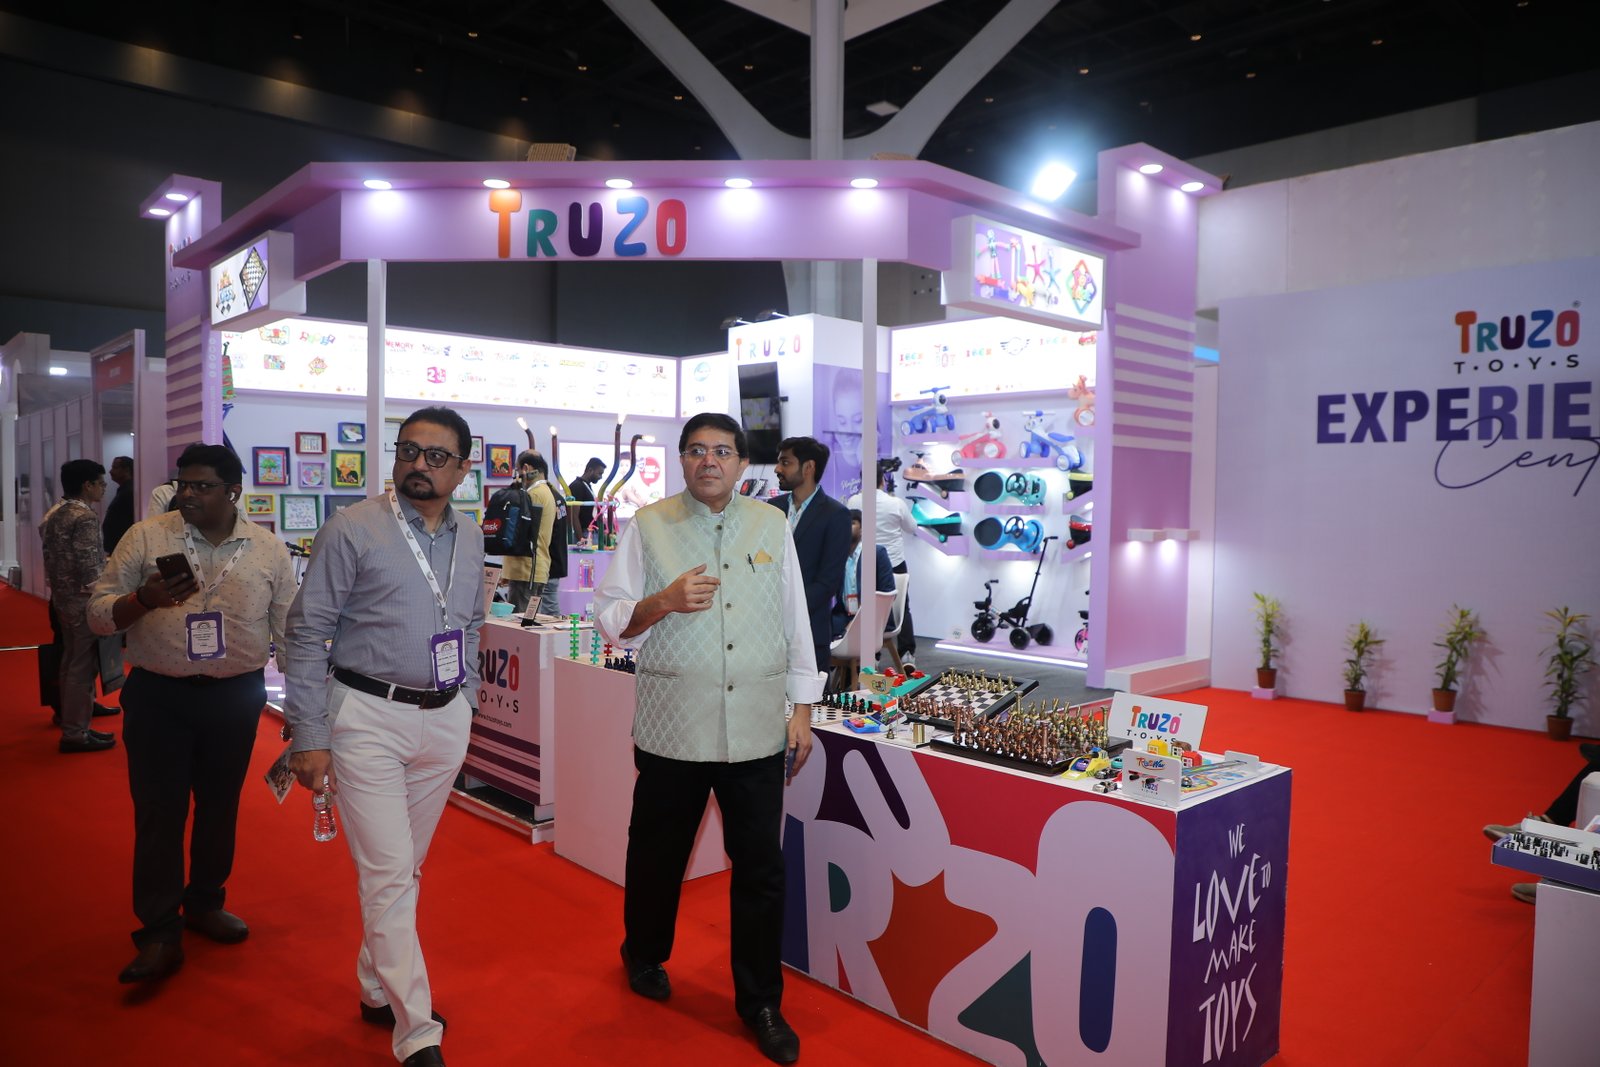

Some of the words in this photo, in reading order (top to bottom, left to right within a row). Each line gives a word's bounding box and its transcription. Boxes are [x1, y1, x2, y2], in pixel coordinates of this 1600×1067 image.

[489, 189, 687, 259] TRUZO
[385, 339, 414, 350] MEMORY
[736, 335, 801, 361] TRUZO
[1454, 309, 1581, 354] TRUZO
[477, 649, 520, 692] RUZO
[1131, 705, 1181, 735] TRUZO
[1228, 823, 1246, 858] WE
[1192, 853, 1262, 943] LOVE
[1261, 861, 1272, 889] TO
[1203, 918, 1257, 984] MAKE
[1198, 962, 1258, 1065] TOYS
